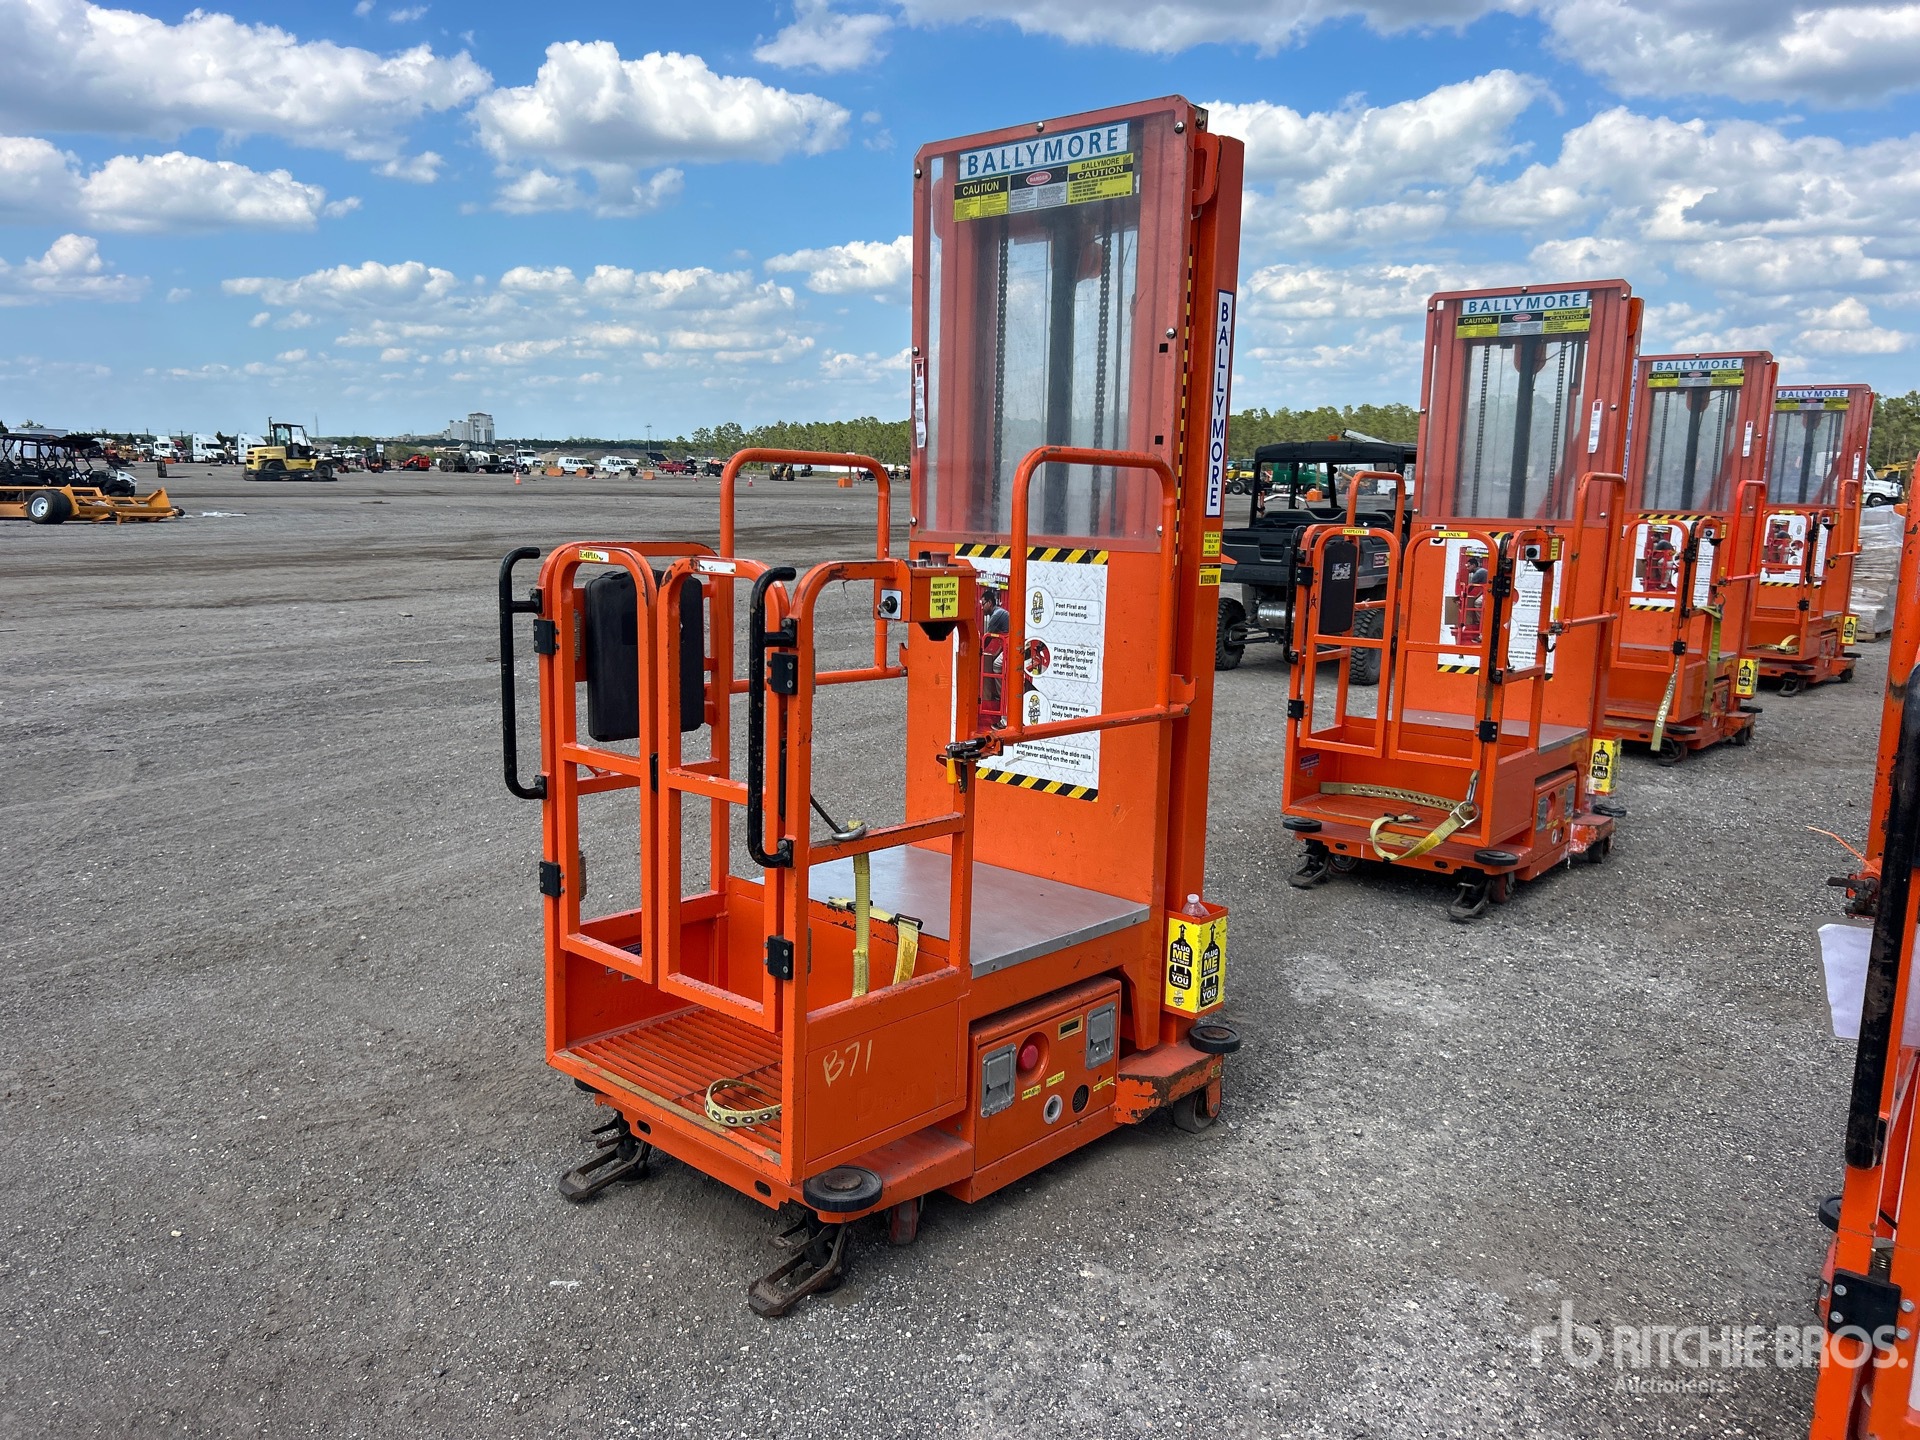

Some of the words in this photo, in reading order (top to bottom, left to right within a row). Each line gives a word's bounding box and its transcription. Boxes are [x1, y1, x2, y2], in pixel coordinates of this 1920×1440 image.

[967, 128, 1119, 176] BALLYMORE
[1081, 157, 1120, 170] BALLYMORE
[1077, 165, 1124, 179] CAUTION
[962, 181, 999, 196] CAUTION
[1468, 293, 1581, 313] BALLYMORE
[1463, 317, 1493, 325] CAUTION
[1656, 360, 1738, 371] BALLYMORE
[1780, 390, 1845, 398] BALLYMORE
[1209, 301, 1229, 507] BALLYMORE
[1053, 646, 1067, 654] Place
[1051, 703, 1068, 711] Always
[1051, 710, 1063, 718] body
[1016, 742, 1033, 750] Always
[1172, 943, 1191, 953] PLUG
[1204, 948, 1219, 960] PLUG
[1172, 949, 1190, 962] ME
[1203, 955, 1218, 971] ME
[1171, 974, 1189, 985] YOU
[1202, 987, 1217, 1001] YOU
[823, 1039, 873, 1088] B71
